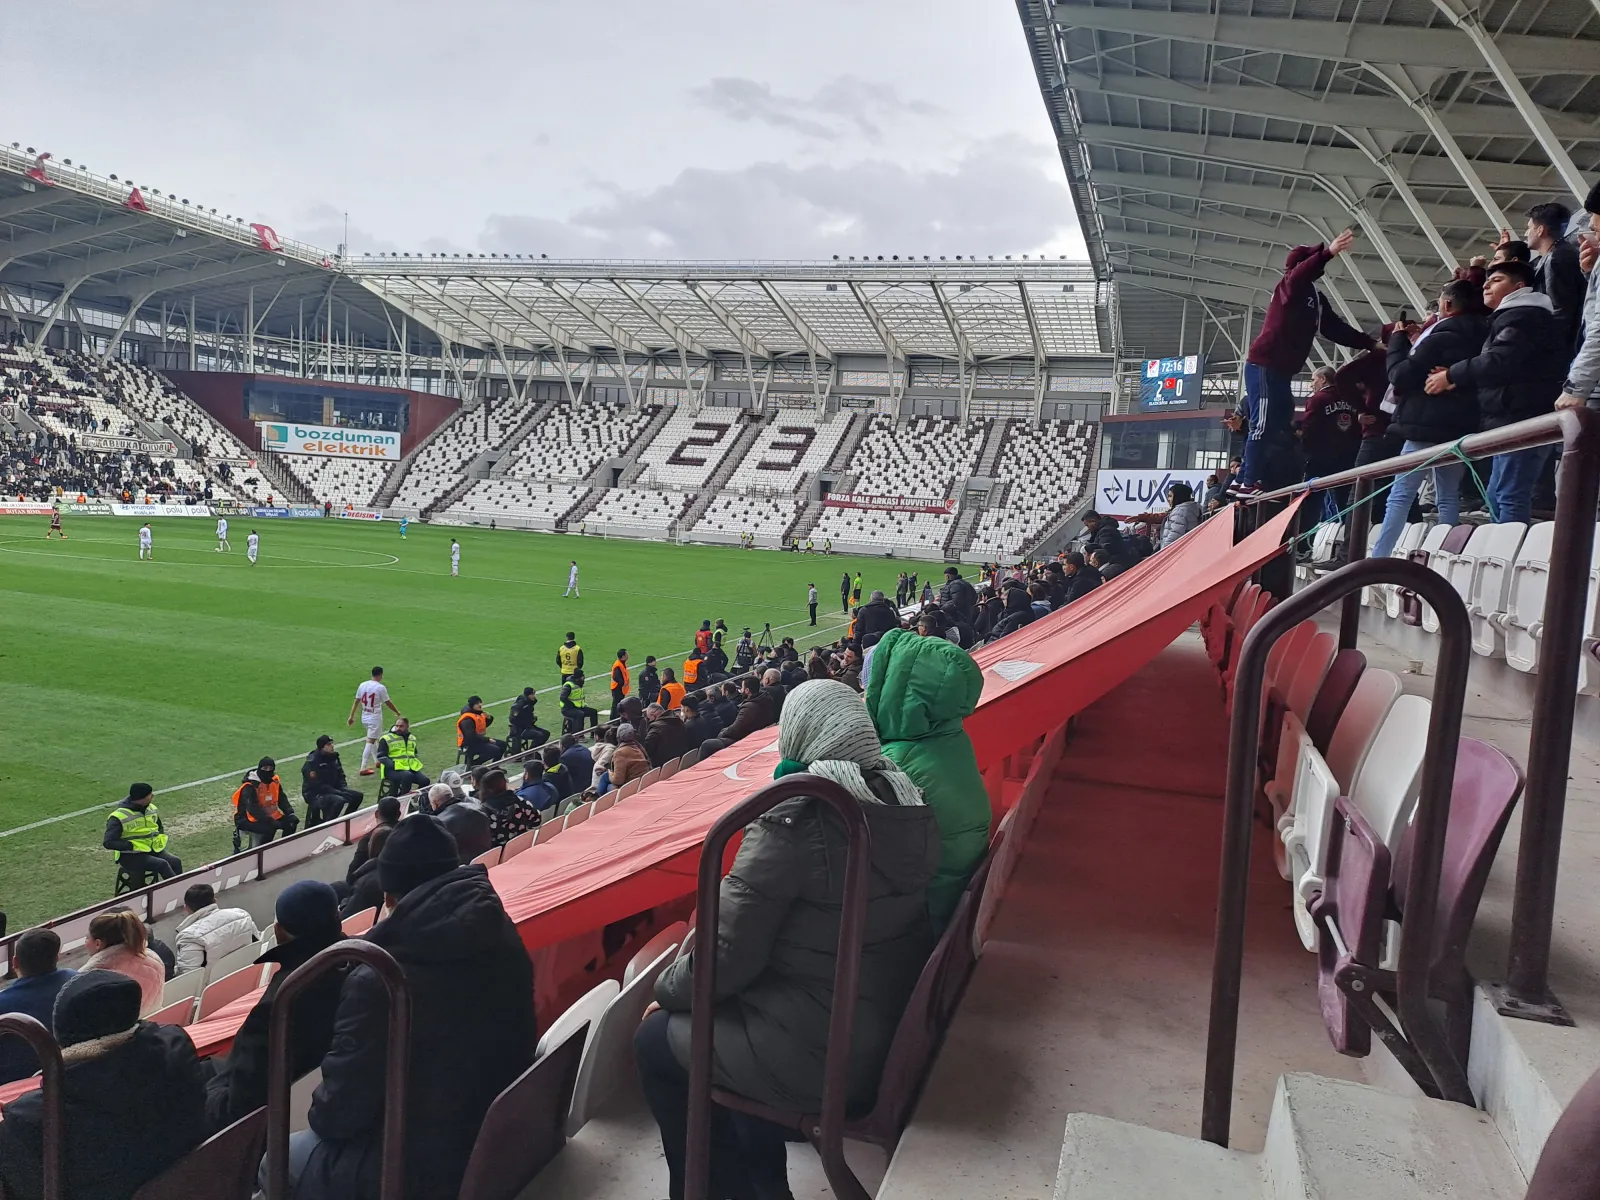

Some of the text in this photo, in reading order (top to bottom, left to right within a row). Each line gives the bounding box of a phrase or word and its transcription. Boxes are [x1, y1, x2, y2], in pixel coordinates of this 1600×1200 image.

[1161, 361, 1183, 373] 72:16
[1156, 379, 1183, 398] 2 0
[294, 426, 396, 445] bozduman
[102, 439, 139, 450] ABLUKA
[302, 440, 387, 457] elektrik
[827, 492, 850, 502] FORZA
[852, 495, 870, 504] KALE
[871, 496, 899, 505] ARKASI
[361, 691, 376, 708] 41
